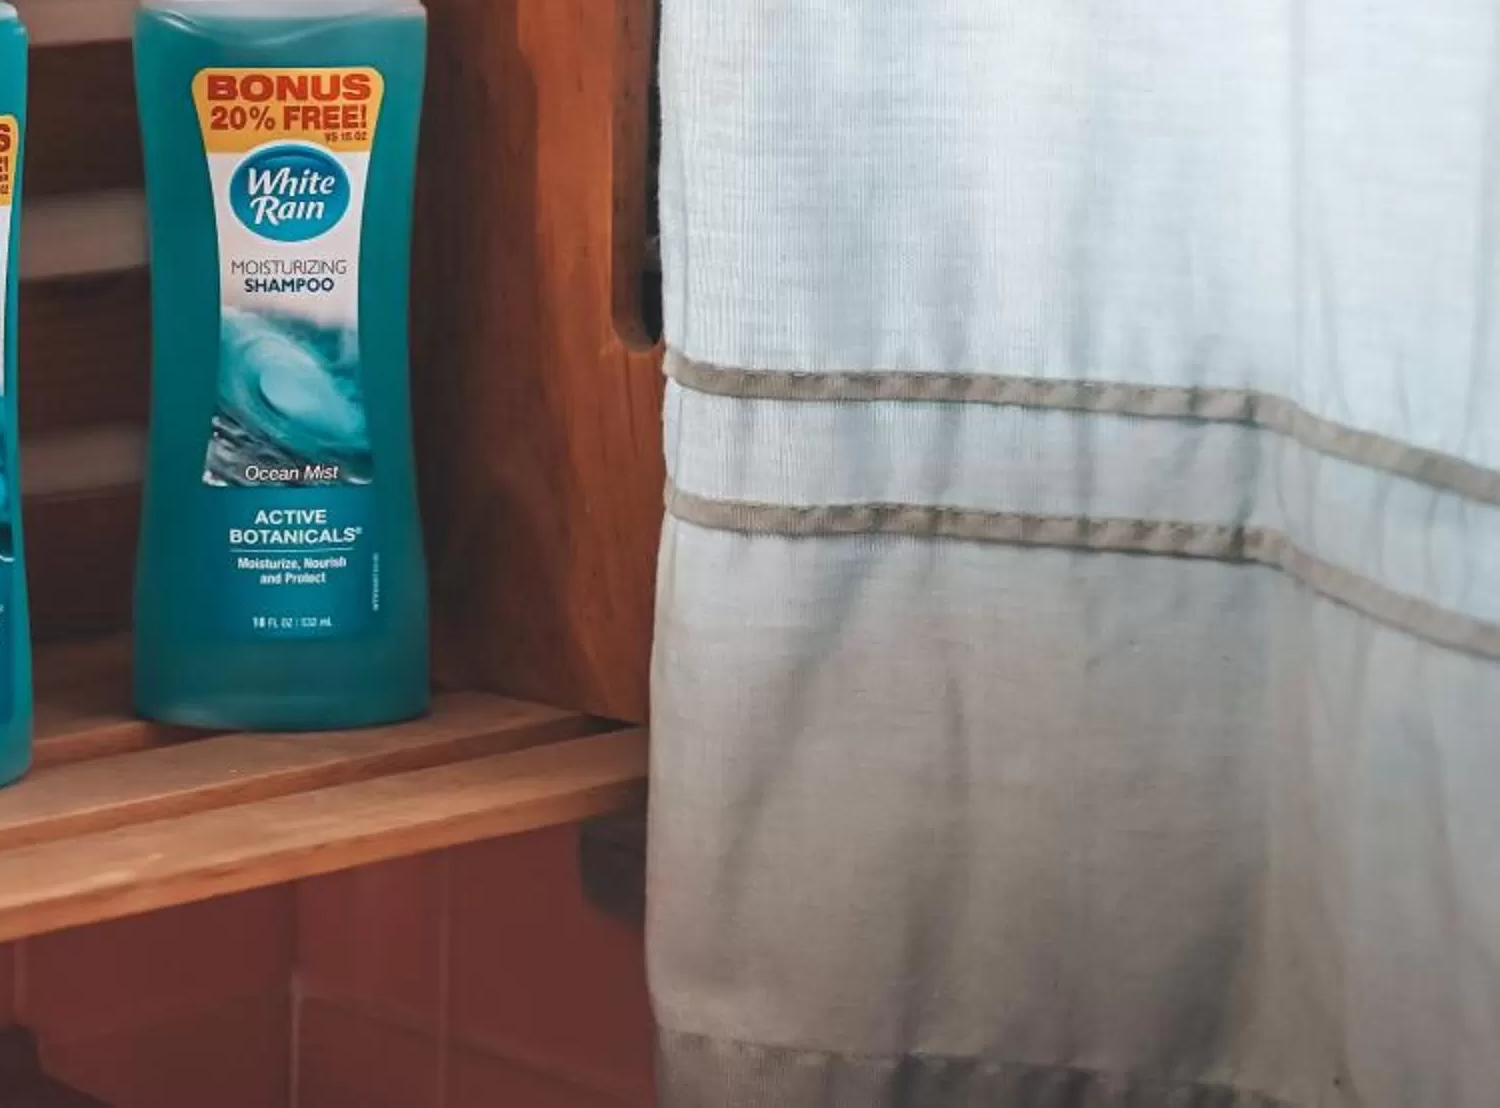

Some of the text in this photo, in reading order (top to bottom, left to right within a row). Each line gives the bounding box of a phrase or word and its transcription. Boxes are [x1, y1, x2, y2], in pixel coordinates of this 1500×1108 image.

[207, 73, 373, 102] BONUS
[210, 103, 368, 132] 20% FREE!
[247, 166, 336, 196] White
[249, 195, 325, 226] Rain
[231, 259, 348, 275] MOISTURIZING
[244, 277, 335, 293] SHAMPOO
[245, 465, 339, 481] Ocean Mist
[254, 509, 328, 526] ACTIVE
[303, 555, 347, 570] Nourish
[260, 571, 326, 584] and Protect
